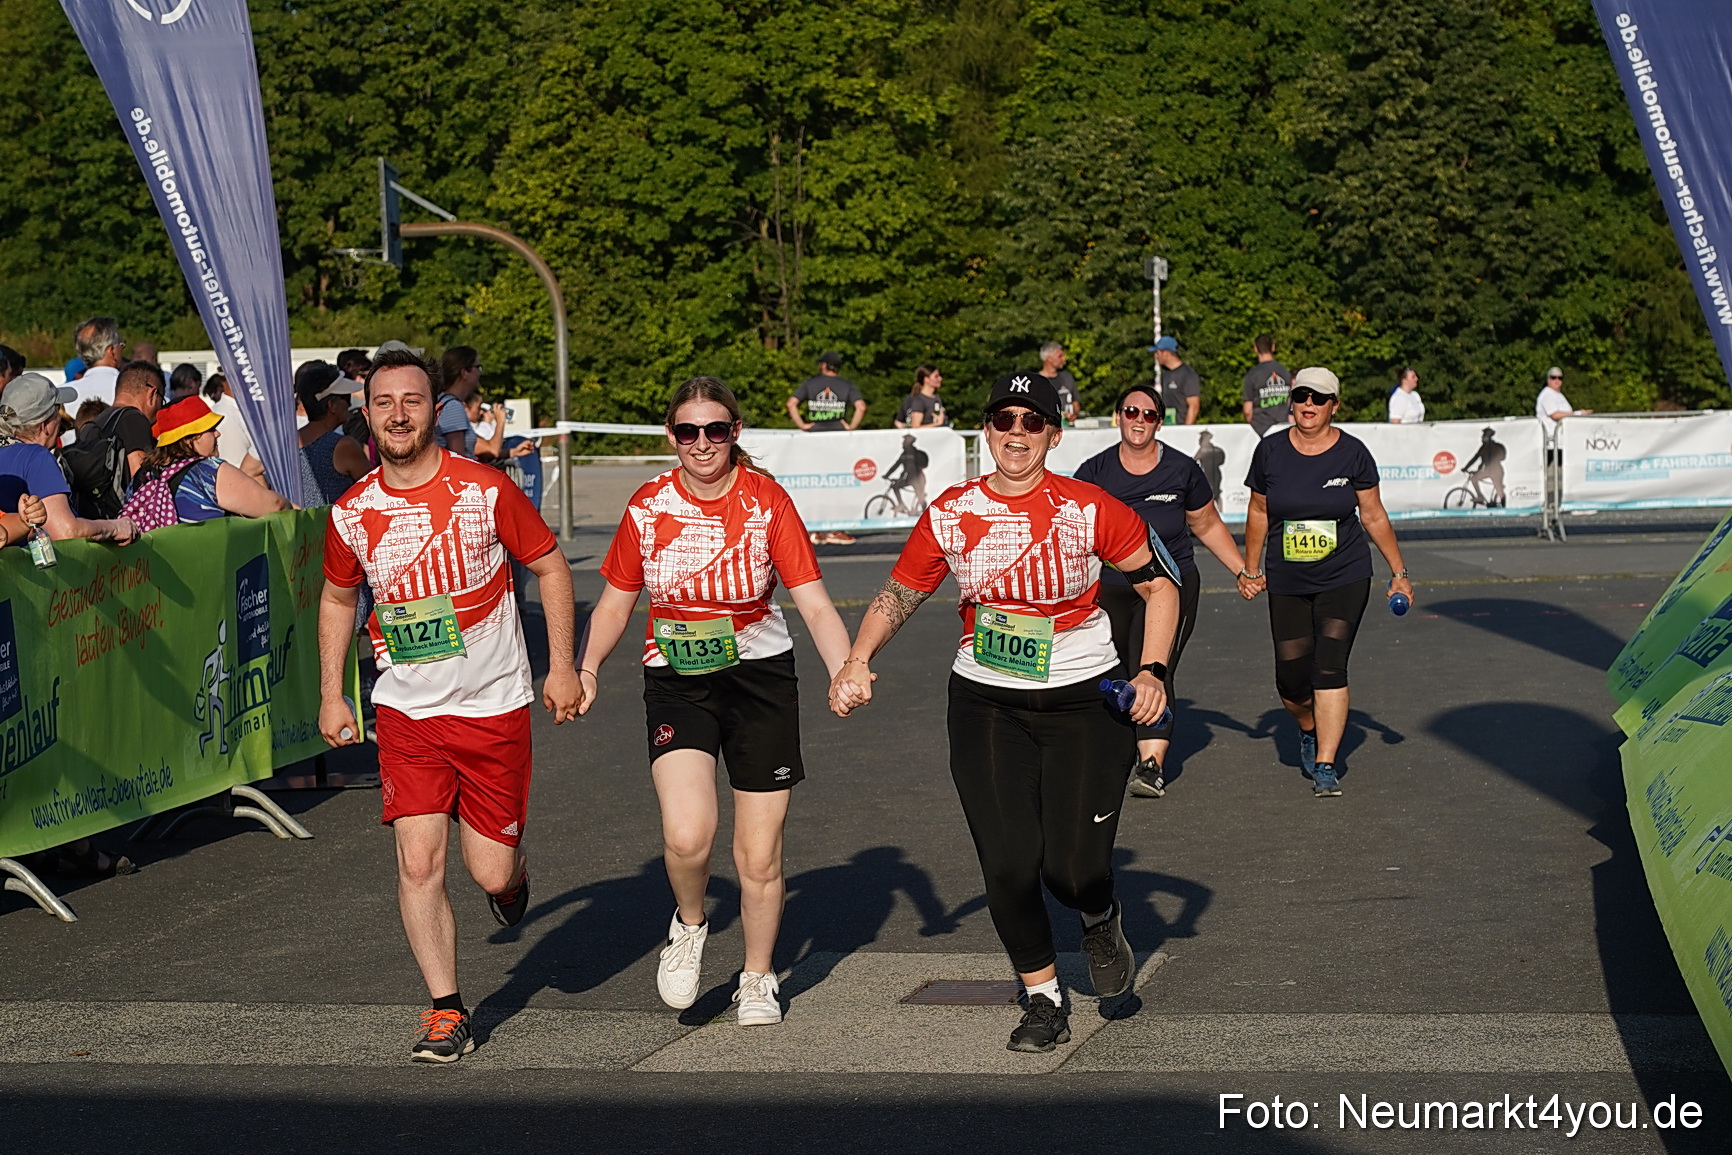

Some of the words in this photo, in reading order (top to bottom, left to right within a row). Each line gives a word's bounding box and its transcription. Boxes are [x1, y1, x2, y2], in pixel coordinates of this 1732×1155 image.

[1585, 438, 1621, 451] NOW
[985, 543, 1009, 551] 52.01
[1291, 534, 1328, 548] 1416
[389, 549, 412, 560] 26.22
[675, 558, 701, 567] 26.22
[985, 555, 1010, 564] 26.22
[48, 564, 106, 628] Gesunde
[110, 558, 151, 599] Firmen
[76, 614, 116, 669] laufen
[118, 586, 164, 650] länger!
[391, 618, 443, 645] 1127
[445, 618, 459, 647] 2022
[385, 632, 397, 653] RUN
[668, 638, 724, 658] 1133
[723, 638, 735, 661] 2022
[976, 632, 984, 654] RUN
[985, 628, 1038, 659] 1106
[679, 658, 699, 666] Riedl
[700, 657, 715, 665] Lea
[981, 648, 1008, 662] Schwarz
[1008, 656, 1037, 668] Melanie
[1036, 643, 1048, 672] 2022
[655, 731, 673, 744] FCN
[31, 756, 174, 830] www.firmenlauf-oberpfalz.de
